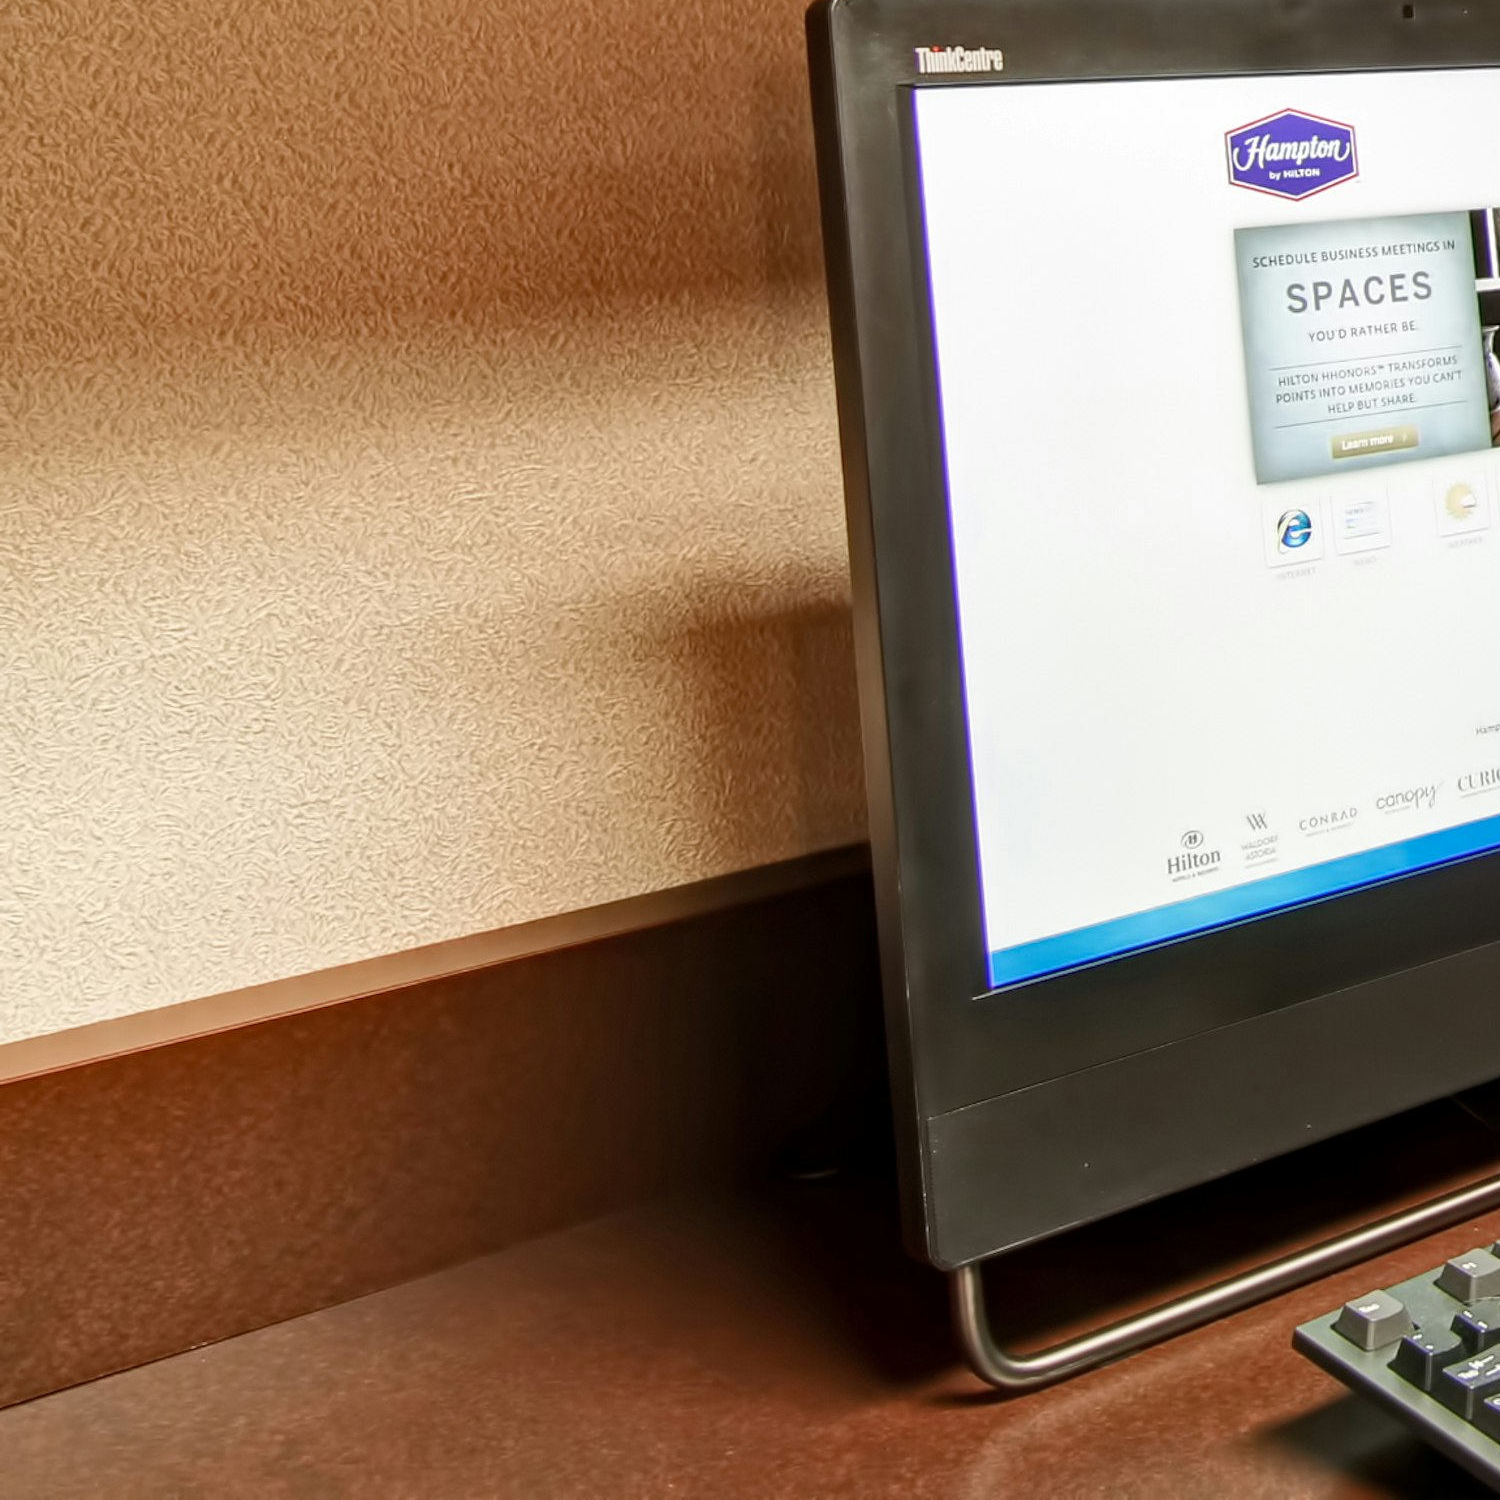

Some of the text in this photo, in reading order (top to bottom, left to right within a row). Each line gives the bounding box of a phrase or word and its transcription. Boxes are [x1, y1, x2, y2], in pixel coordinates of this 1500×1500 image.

[914, 45, 1003, 73] ThinkCentre
[1233, 134, 1350, 171] Hampton
[1269, 168, 1320, 180] by HILTON
[1252, 240, 1455, 268] SCHEDULE BUSINESS MEETINGS IN
[1286, 271, 1432, 314] SPACES
[1308, 328, 1347, 342] YOU'D
[1350, 322, 1398, 337] RATHER
[1278, 373, 1319, 387] HILTON
[1388, 355, 1458, 373] TRANSFORMS
[1276, 370, 1462, 404] POINTS INTO MEMORIES YOU CAN'T
[1327, 401, 1355, 414] HELP
[1357, 398, 1377, 410] BUT
[1342, 434, 1394, 450] Learn more
[1376, 782, 1443, 809] canopy
[1299, 807, 1358, 831] CONRAD
[1167, 850, 1221, 874] Hilton
